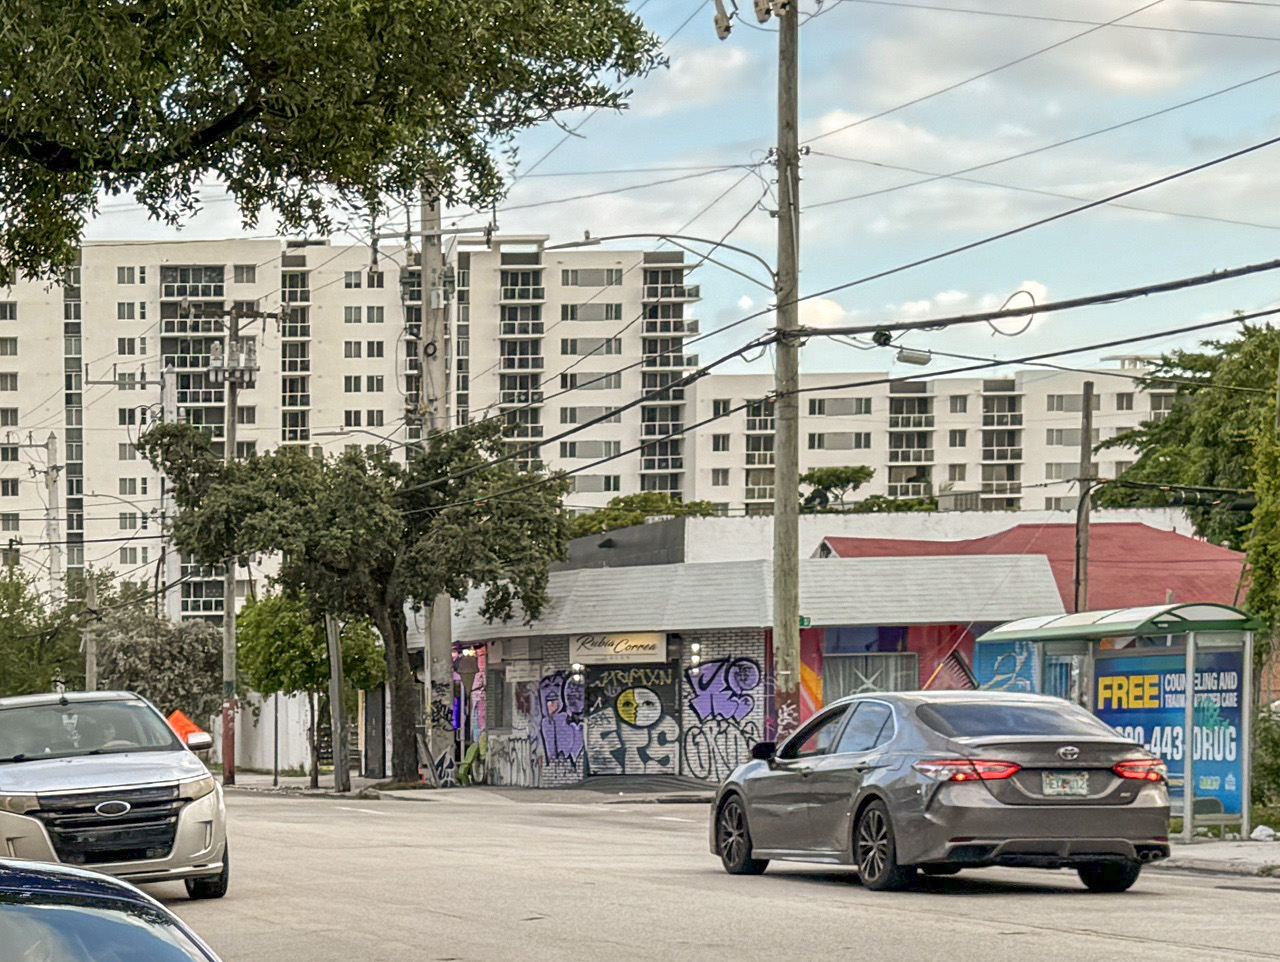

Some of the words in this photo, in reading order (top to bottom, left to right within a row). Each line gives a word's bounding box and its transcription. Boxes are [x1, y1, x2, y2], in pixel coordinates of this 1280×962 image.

[576, 633, 615, 652] Rubia
[613, 638, 657, 654] Correa
[1097, 674, 1160, 710] FREE
[1164, 671, 1219, 692] COUNELING
